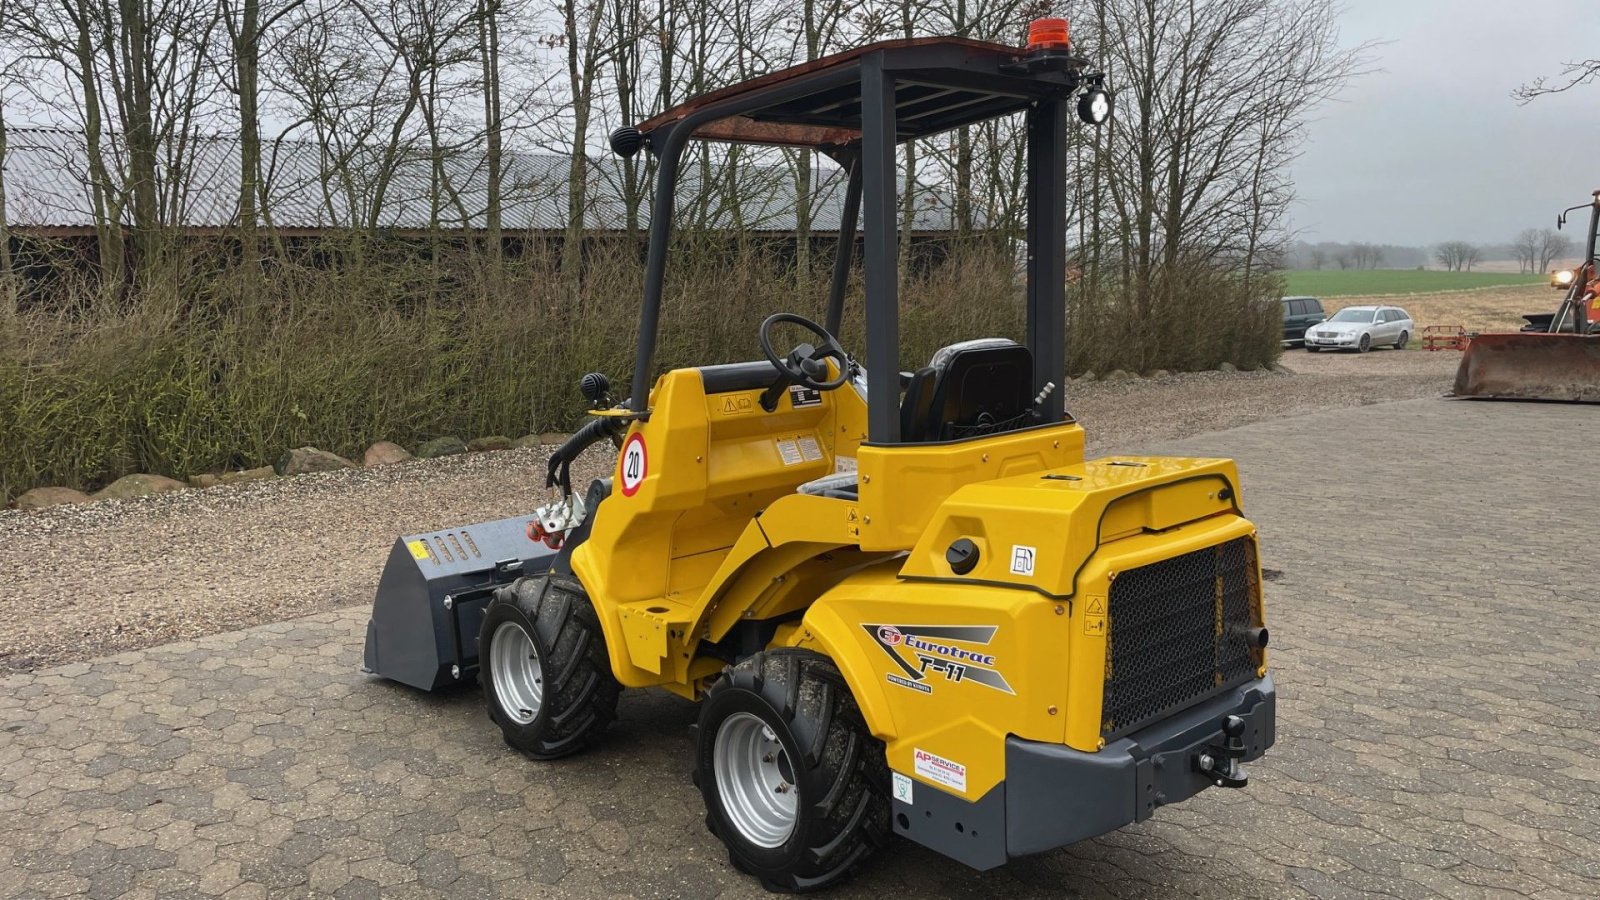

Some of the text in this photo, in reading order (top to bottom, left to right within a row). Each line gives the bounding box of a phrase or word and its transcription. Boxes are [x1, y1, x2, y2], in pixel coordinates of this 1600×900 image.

[627, 451, 639, 479] 20
[905, 634, 995, 665] Eurotrac
[919, 657, 966, 682] T-11
